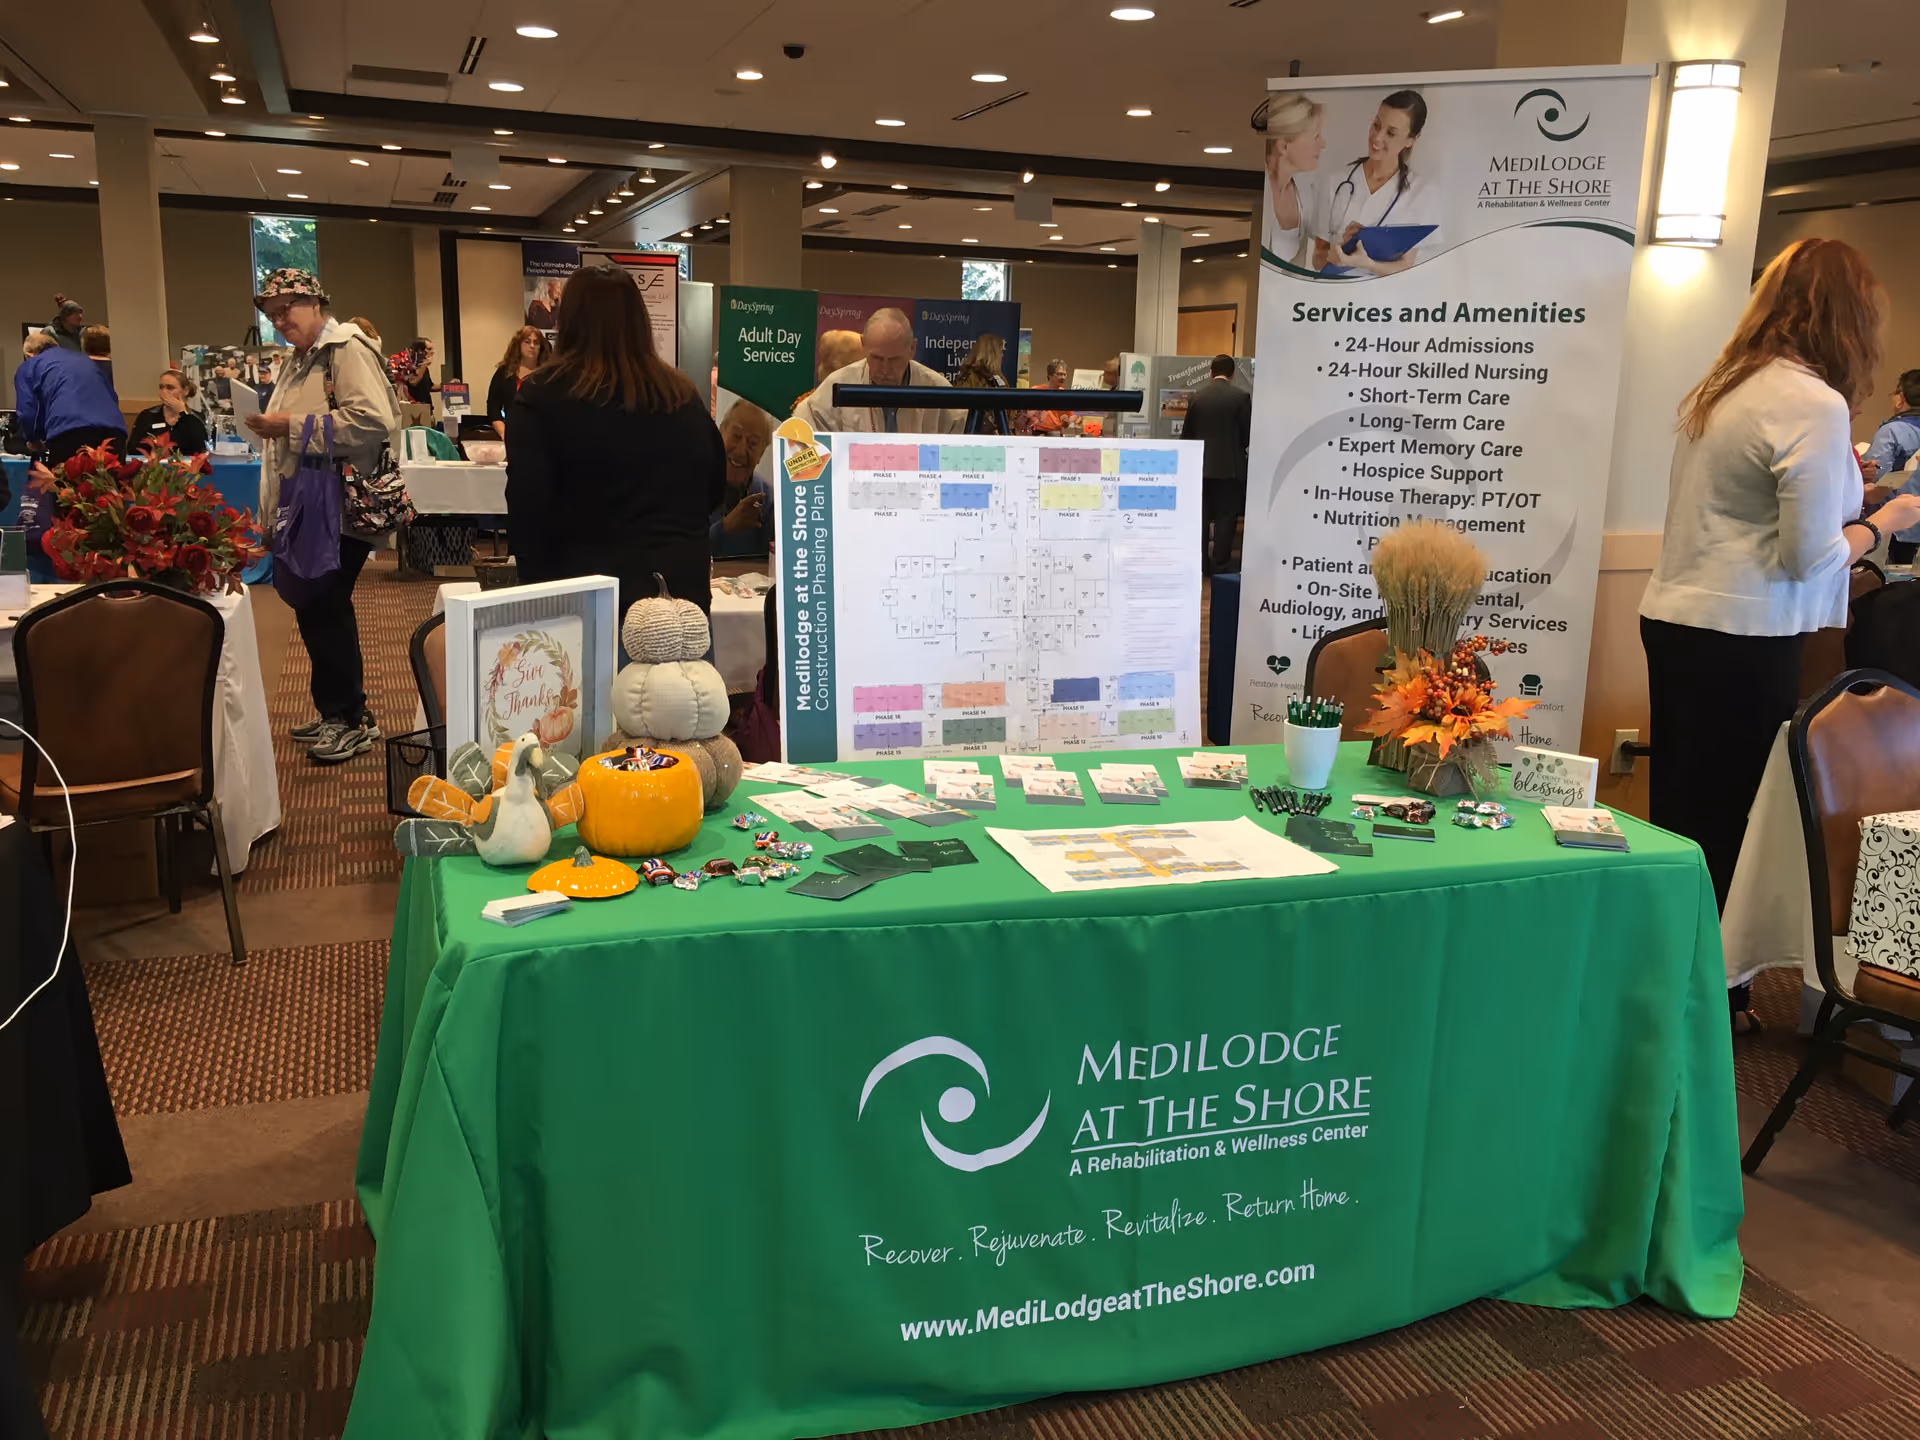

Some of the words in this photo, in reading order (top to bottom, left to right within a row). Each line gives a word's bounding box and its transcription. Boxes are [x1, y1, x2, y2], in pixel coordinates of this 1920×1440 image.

[1489, 154, 1607, 173] MEDILODGE
[1478, 181, 1502, 196] AT
[1506, 178, 1543, 195] THE
[1548, 177, 1612, 195] SHORE
[1476, 201, 1484, 209] A
[1485, 199, 1539, 208] Rehabilitation
[1540, 200, 1546, 208] &
[1547, 199, 1582, 208] Wellness
[1584, 199, 1610, 207] Center
[526, 267, 547, 276] People
[561, 268, 574, 276] Hear
[529, 260, 541, 268] The
[541, 261, 565, 270] Ultimate
[565, 262, 580, 270] Phon
[736, 300, 775, 315] DaySpring
[819, 305, 862, 319] DaySpring
[927, 311, 970, 324] DaySpring
[1291, 301, 1393, 324] Services
[1399, 301, 1448, 323] and
[1453, 301, 1586, 324] Amenities
[737, 326, 774, 344] Adult
[777, 328, 802, 349] Day
[1345, 336, 1421, 354] 24-Hour
[1424, 337, 1535, 355] Admissions
[743, 346, 796, 363] Services
[1327, 361, 1403, 379] 24-Hour
[1406, 362, 1469, 380] Skilled
[1474, 363, 1549, 385] Nursing
[443, 384, 467, 393] FREE
[1359, 387, 1463, 406] Short-Term
[1467, 389, 1511, 406] Care
[1359, 412, 1458, 433] Long-Term
[1462, 414, 1506, 432] Care
[788, 450, 815, 467] UNDER
[1338, 436, 1396, 456] Expert
[1400, 438, 1476, 460] Memory
[1480, 440, 1524, 458] Care
[1352, 462, 1426, 482] Hospice
[1430, 464, 1504, 485] Support
[811, 484, 825, 521] Plan
[1313, 485, 1395, 503] In-House
[1399, 488, 1476, 509] Therapy:
[1481, 491, 1542, 510] PT/OT
[793, 485, 808, 542] Shore
[1323, 509, 1400, 528] Nutrition
[1406, 513, 1526, 535] Mnagement
[794, 547, 808, 580] the
[812, 527, 828, 595] Phasing
[1292, 556, 1354, 575] Patient
[1485, 567, 1552, 585] ucation
[795, 584, 809, 604] at
[1307, 581, 1373, 599] On-Site
[1475, 591, 1525, 611] ental,
[1259, 598, 1347, 621] Audiology,
[1351, 606, 1384, 620] and
[1488, 612, 1568, 633] Services
[795, 609, 812, 711] Medilodge
[813, 600, 829, 712] Construction
[513, 659, 545, 689] Give
[1249, 679, 1279, 689] Restore
[502, 683, 554, 720] Thanks
[1534, 702, 1564, 712] omfort
[1513, 771, 1585, 807] blessings
[1536, 773, 1561, 784] COUNT
[1563, 778, 1582, 787] YOUR
[1077, 1023, 1342, 1086] MEDILODGE
[1071, 1104, 1125, 1146] AT
[1138, 1095, 1220, 1137] THE
[1232, 1075, 1373, 1125] SHORE
[1069, 1158, 1083, 1177] A
[1087, 1143, 1211, 1174] Rehabilitation
[1213, 1139, 1227, 1157] &
[1231, 1131, 1308, 1154] Wellness
[1311, 1123, 1369, 1143] Center
[1222, 1191, 1297, 1223] Return
[900, 1262, 1316, 1342] www.MediLodgeatTheShore.com
